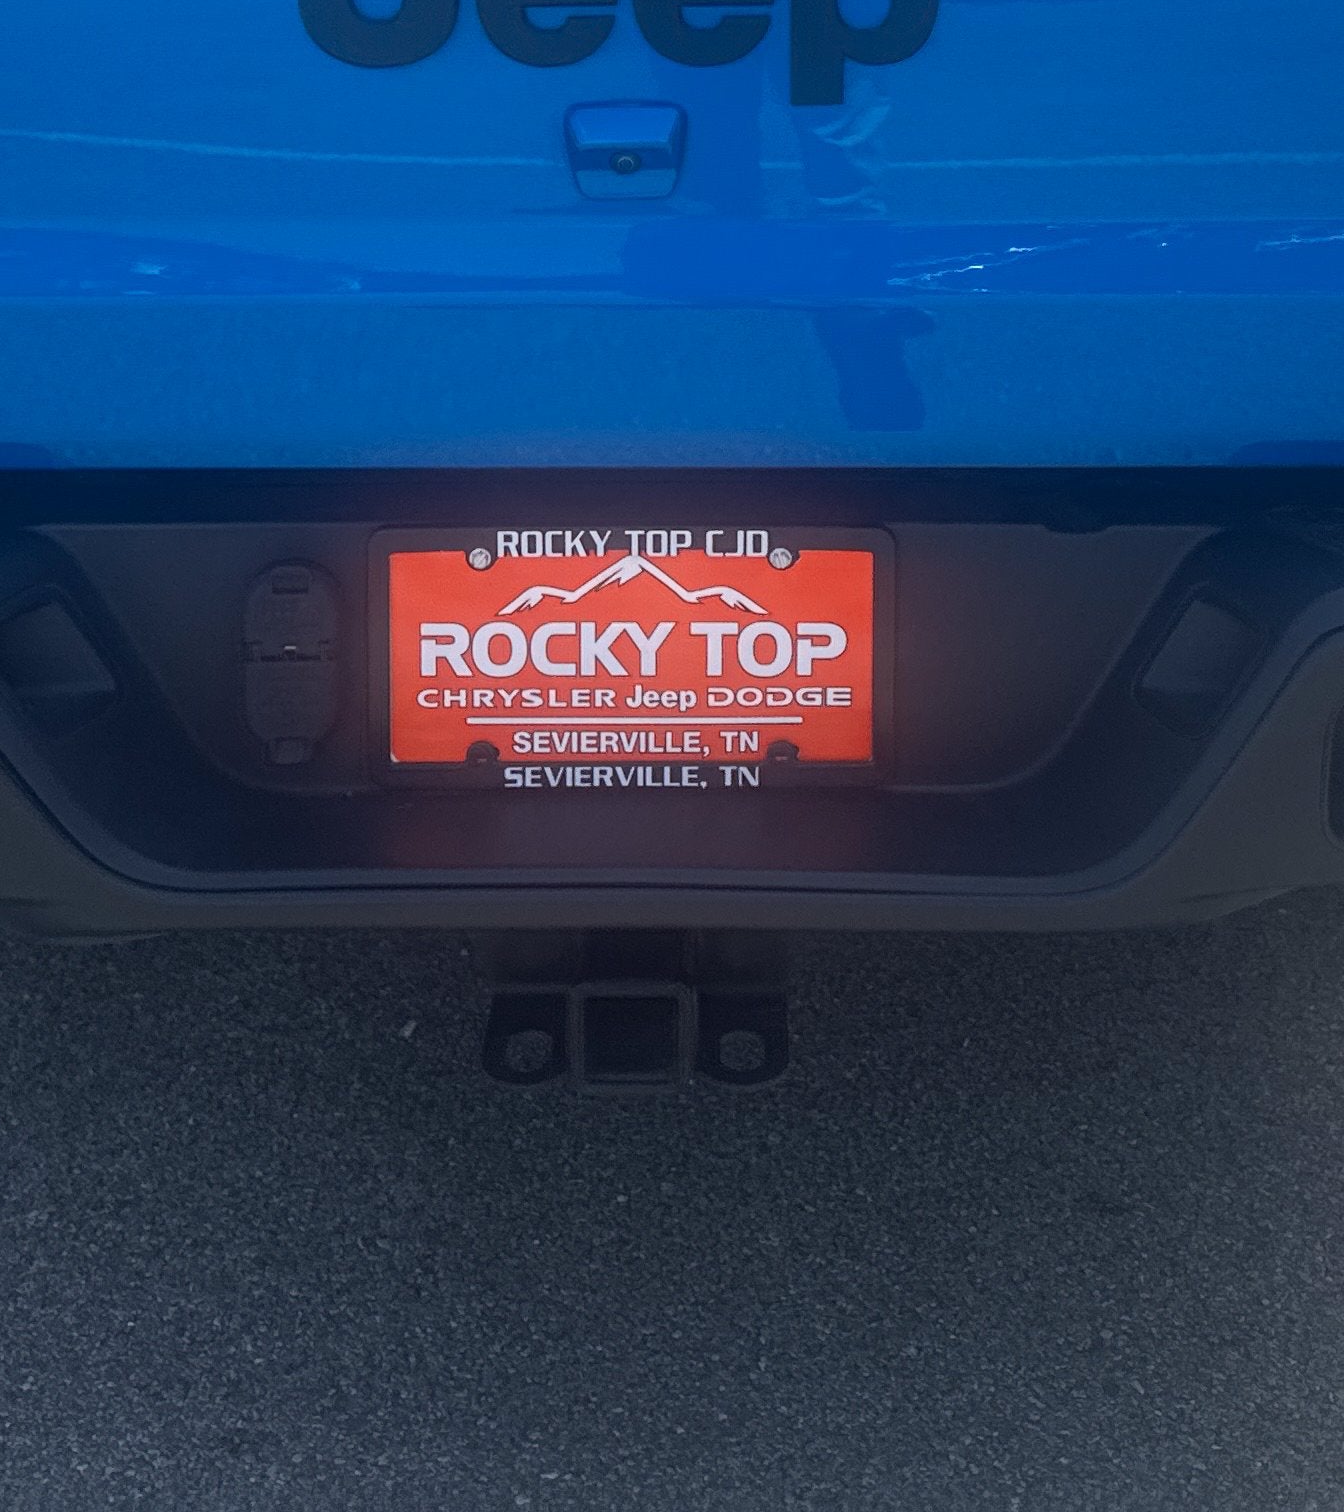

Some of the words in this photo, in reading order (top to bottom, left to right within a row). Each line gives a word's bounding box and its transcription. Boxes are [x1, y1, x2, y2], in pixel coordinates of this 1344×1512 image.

[496, 530, 612, 557] ROCKY
[625, 530, 693, 557] TOP
[705, 530, 770, 557] CJD
[419, 622, 676, 677] ROCKY
[689, 622, 848, 677] TOP
[417, 688, 617, 709] CHRYSLER
[625, 685, 698, 712] Jeep
[707, 687, 852, 708] DODGE
[512, 731, 710, 757] SEVIERVILLE,
[720, 731, 759, 753] TN
[719, 766, 760, 788] TN
